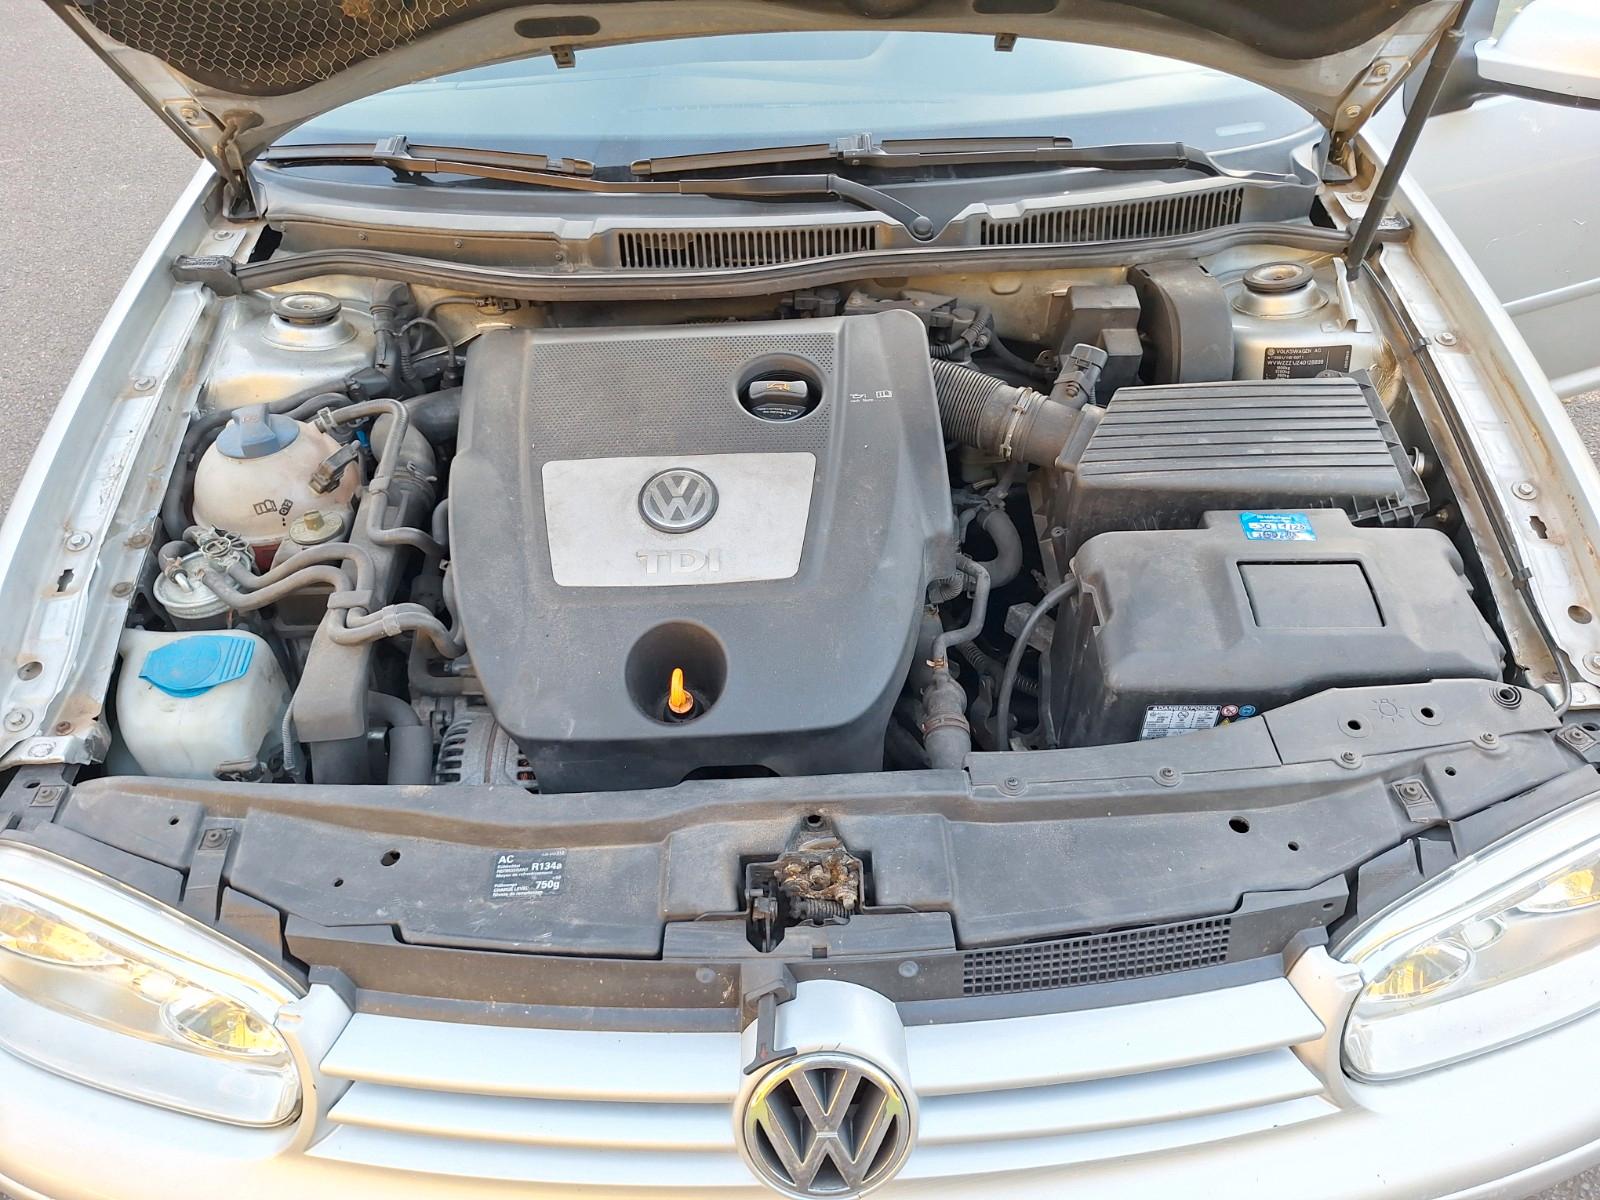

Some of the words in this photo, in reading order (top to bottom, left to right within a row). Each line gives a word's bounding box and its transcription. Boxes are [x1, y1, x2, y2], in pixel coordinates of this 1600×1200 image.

[636, 549, 720, 573] TDI
[498, 855, 514, 864] AC
[531, 861, 562, 871] R134a
[535, 880, 560, 890] 750g
